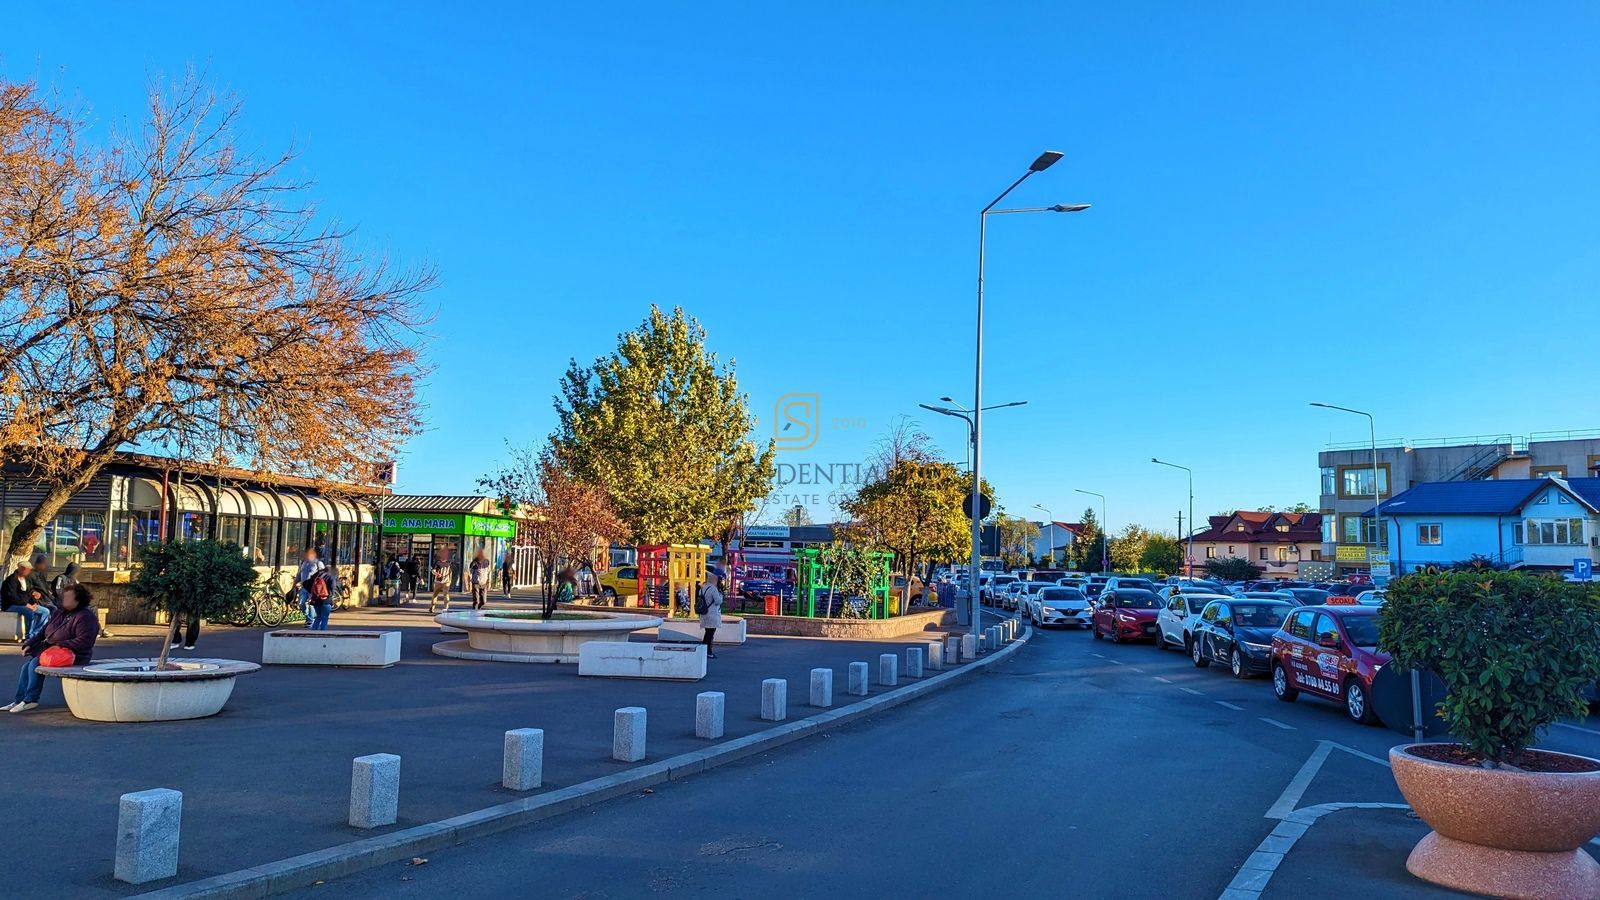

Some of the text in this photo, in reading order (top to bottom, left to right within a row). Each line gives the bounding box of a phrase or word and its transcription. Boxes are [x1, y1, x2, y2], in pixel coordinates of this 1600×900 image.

[401, 518, 421, 529] ANA
[423, 518, 455, 529] MARIA
[1578, 561, 1588, 573] P
